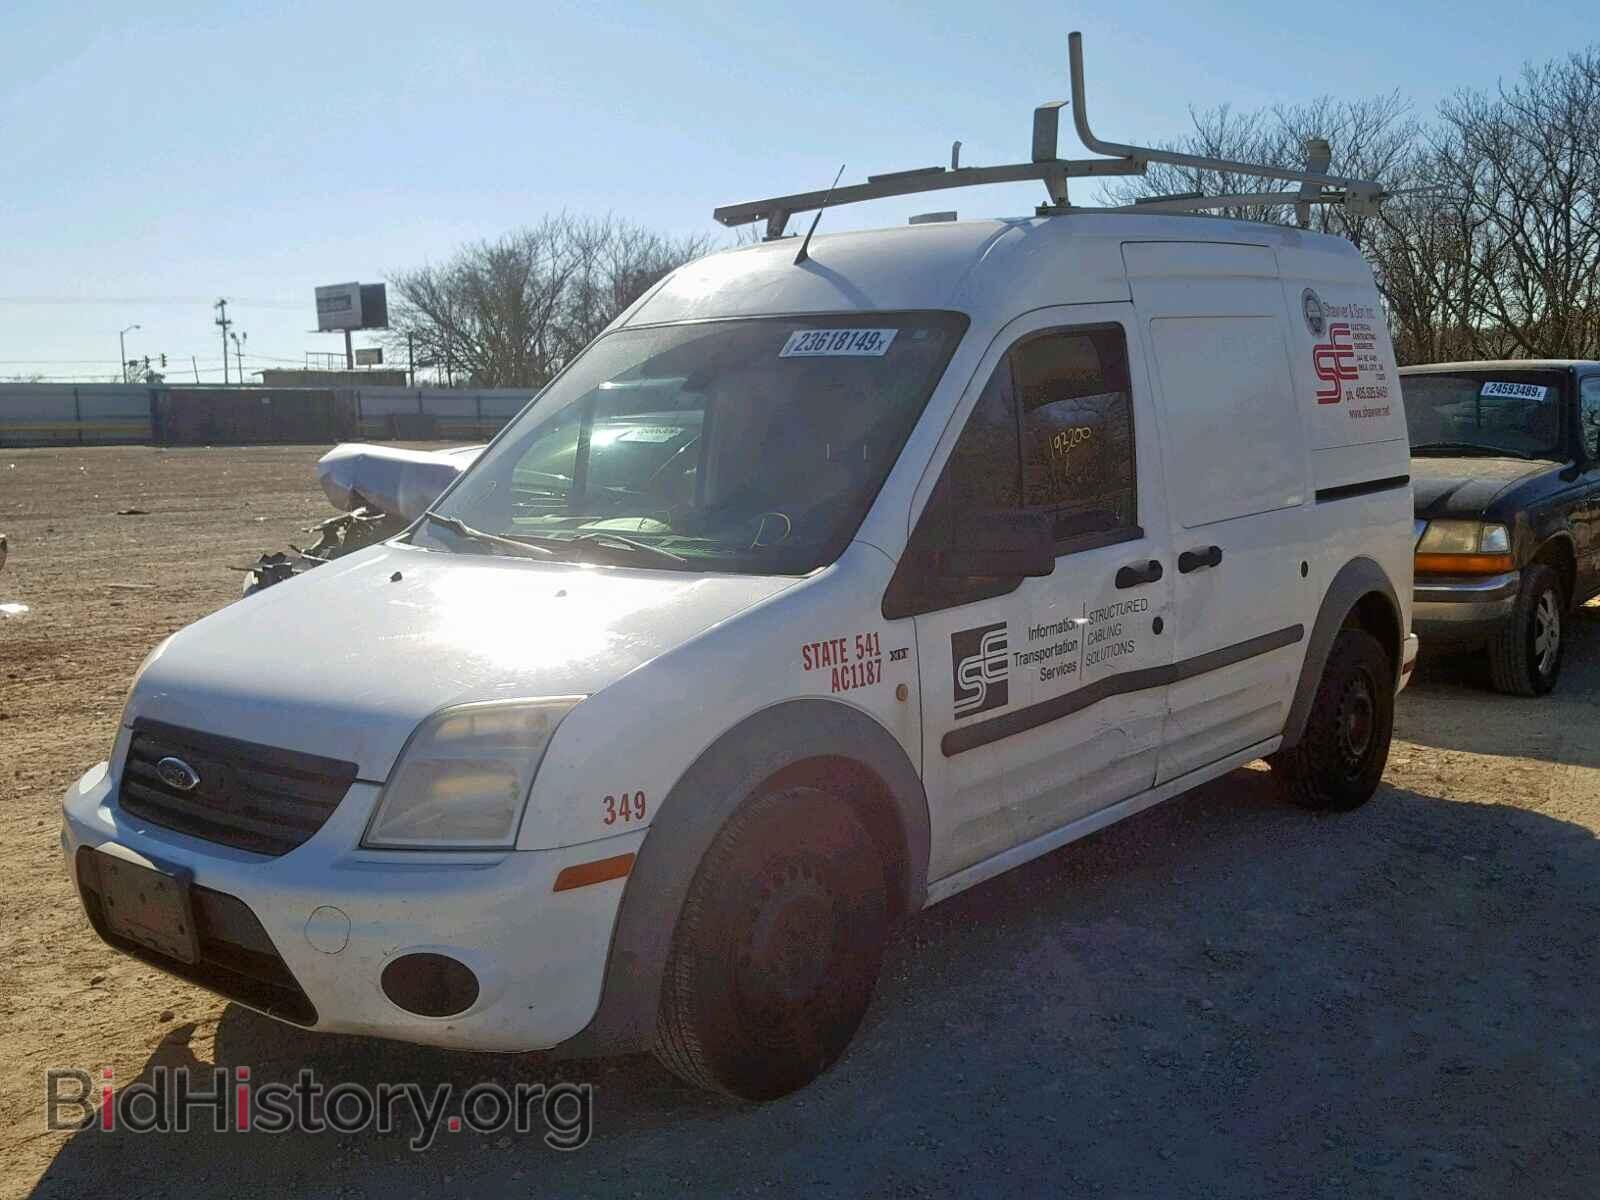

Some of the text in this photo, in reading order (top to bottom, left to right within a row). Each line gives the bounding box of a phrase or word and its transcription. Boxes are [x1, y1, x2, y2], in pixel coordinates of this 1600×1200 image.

[1088, 598, 1148, 626] STRUCTURED
[1028, 616, 1080, 641] Information
[1087, 623, 1122, 645] CABLING
[802, 631, 881, 671] STATE 541
[1012, 639, 1078, 667] Transportation
[1086, 639, 1135, 668] SOLUTIONS
[831, 659, 882, 693] AC1187
[1039, 660, 1077, 682] Services
[603, 790, 646, 825] 349
